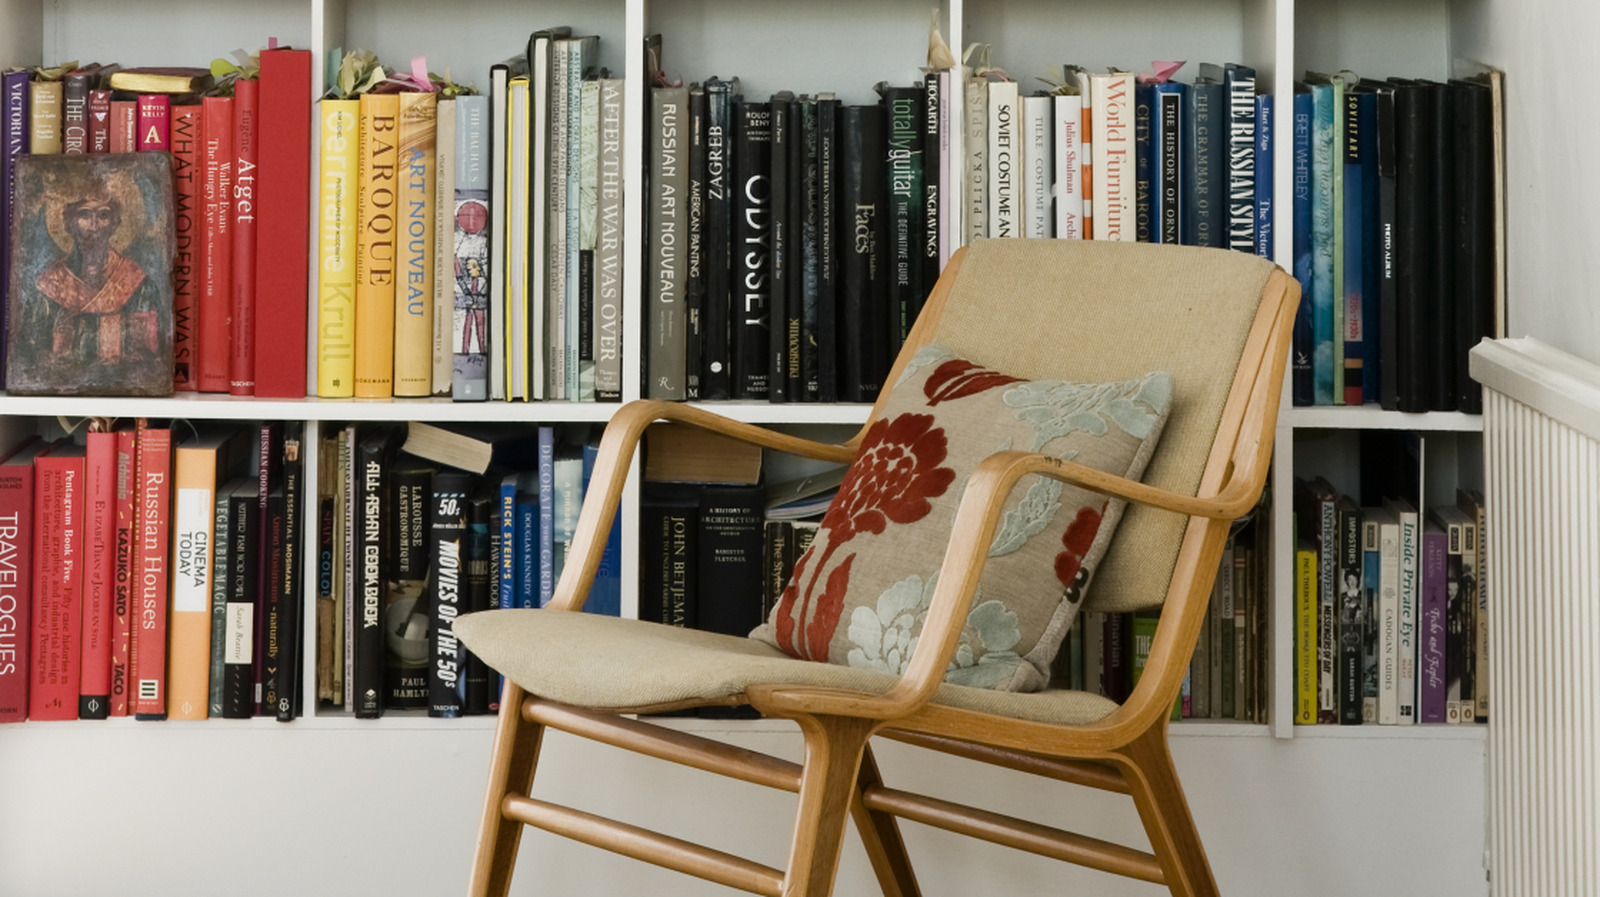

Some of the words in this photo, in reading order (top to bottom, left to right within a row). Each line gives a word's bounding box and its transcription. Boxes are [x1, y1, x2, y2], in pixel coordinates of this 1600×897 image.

[11, 82, 22, 155] VICTORIAN
[66, 96, 85, 121] THE
[470, 108, 480, 127] THE
[927, 79, 937, 134] HOGARTH
[968, 96, 983, 138] SPIŠ
[1106, 79, 1127, 141] World
[1167, 103, 1175, 126] THE
[1198, 94, 1208, 122] THE
[1230, 77, 1255, 118] THE
[1261, 107, 1269, 124] Hart
[1349, 96, 1358, 134] SOVIET
[95, 129, 106, 151] The
[144, 125, 162, 144] A
[603, 87, 619, 153] AFTER
[661, 104, 676, 176] RUSSIAN
[998, 104, 1011, 149] SOVIET
[1035, 117, 1043, 149] TILKE
[1064, 121, 1076, 148] Julius
[1137, 104, 1149, 146] CITY
[1296, 114, 1309, 146] BRETT
[174, 115, 192, 183] WHAT
[207, 138, 219, 159] The
[359, 114, 367, 177] Architecture
[470, 132, 480, 183] BAUHAUS
[708, 126, 722, 200] ZAGREB
[1167, 132, 1175, 182] HISTORY
[1198, 128, 1208, 195] GRAMMAR
[1230, 122, 1255, 200] RUSSIAN
[1260, 134, 1269, 151] Ziga
[1349, 137, 1358, 158] ART
[204, 161, 218, 200] Hungry
[219, 162, 230, 199] Walker
[233, 157, 256, 224] Atget
[323, 111, 355, 272] Germaine
[408, 147, 426, 193] ART
[602, 156, 619, 200] THE
[973, 151, 983, 214] PLICKA
[998, 151, 1011, 217] COSTUME
[1035, 158, 1043, 212] COSTUME
[1066, 150, 1077, 194] Shulman
[1296, 148, 1309, 201] WHITELEY
[204, 203, 218, 224] Eye
[367, 114, 395, 286] BAROQUE
[551, 176, 559, 212] CENTURY
[558, 178, 566, 214] DESIGNS
[660, 185, 676, 217] ART
[690, 179, 700, 232] AMERICAN
[898, 201, 907, 216] THE
[1106, 149, 1127, 242] Furniture
[1167, 187, 1175, 204] OF
[1199, 199, 1208, 216] OF
[1259, 198, 1271, 221] The
[1316, 168, 1331, 229] sluncem
[219, 202, 230, 234] Evans
[601, 203, 618, 252] WAR
[855, 203, 875, 253] Faces
[898, 218, 907, 260] DEFINITIVE
[926, 184, 937, 257] ENGRAVINGS
[174, 193, 191, 296] MODERN
[357, 243, 365, 285] Painting
[408, 200, 425, 317] NOUVEAU
[660, 223, 674, 303] NOUVEAU
[689, 234, 700, 278] PAINTING
[745, 174, 770, 330] ODYSSEY
[600, 254, 618, 298] WAS
[898, 262, 907, 286] GUIDE
[174, 306, 190, 358] WAS
[322, 282, 352, 361] Krull
[600, 303, 617, 362] OVER
[789, 318, 800, 378] DUBROVNIK
[259, 429, 270, 467] RUSSIAN
[63, 470, 75, 525] Pentagram
[117, 451, 131, 500] Alchimia
[259, 468, 268, 509] COOKING
[287, 473, 295, 491] THE
[365, 460, 380, 491] ALL
[541, 444, 551, 521] DECORATE
[53, 470, 63, 532] architecture,
[144, 471, 164, 549] Russian
[285, 493, 294, 540] ESSENTIAL
[365, 493, 380, 541] ASIAN
[412, 485, 422, 547] LAROUSSE
[438, 498, 461, 516] 50s
[503, 496, 512, 527] RICK
[41, 512, 52, 572] international
[63, 529, 74, 556] Book
[93, 500, 105, 571] ELIZABETHAN
[214, 499, 227, 572] VEGETABLE
[271, 514, 281, 542] Anton
[399, 485, 409, 573] GASTRONOMIQUE
[524, 512, 532, 553] DOUGLAS
[671, 516, 685, 556] JOHN
[773, 536, 784, 558] The
[1323, 504, 1333, 557] ANTHONY
[1347, 516, 1357, 565] IMPOSTORS
[1403, 522, 1415, 565] Inside
[62, 560, 73, 583] Five.
[116, 527, 129, 583] KAZUKO
[179, 531, 192, 577] TODAY
[193, 531, 207, 588] CINEMA
[270, 544, 281, 602] Mosimann
[284, 543, 293, 595] MOSIMANN
[438, 540, 459, 601] MOVIES
[490, 535, 501, 607] HAWKSMOOR
[503, 532, 512, 580] STEIN'S
[524, 554, 532, 596] KENNEDY
[0, 511, 18, 676] TRAVELOGUES
[143, 555, 161, 630] Houses
[213, 573, 226, 614] MAGIC
[771, 561, 784, 594] Styles
[1323, 557, 1333, 600] POWELL
[1402, 569, 1414, 618] Private
[38, 574, 50, 630] consultancy
[90, 580, 103, 626] JACOBEAN
[116, 585, 127, 616] SATO
[235, 606, 245, 630] Sarah
[1426, 607, 1443, 634] Tycho
[51, 601, 61, 649] industrial
[234, 632, 243, 660] Beattie
[437, 627, 458, 657] THE
[1323, 605, 1332, 649] MESSENGERS
[1385, 608, 1393, 654] CADOGAN
[1401, 621, 1413, 647] Eye
[38, 634, 49, 684] Pentagram
[48, 652, 60, 684] design
[62, 635, 72, 673] histories
[437, 659, 458, 689] 50s
[1323, 659, 1332, 674] DAY
[1385, 657, 1393, 691] GUIDES
[1425, 653, 1442, 688] Kepler
[114, 663, 125, 695] TACO
[401, 677, 426, 687] PAUL
